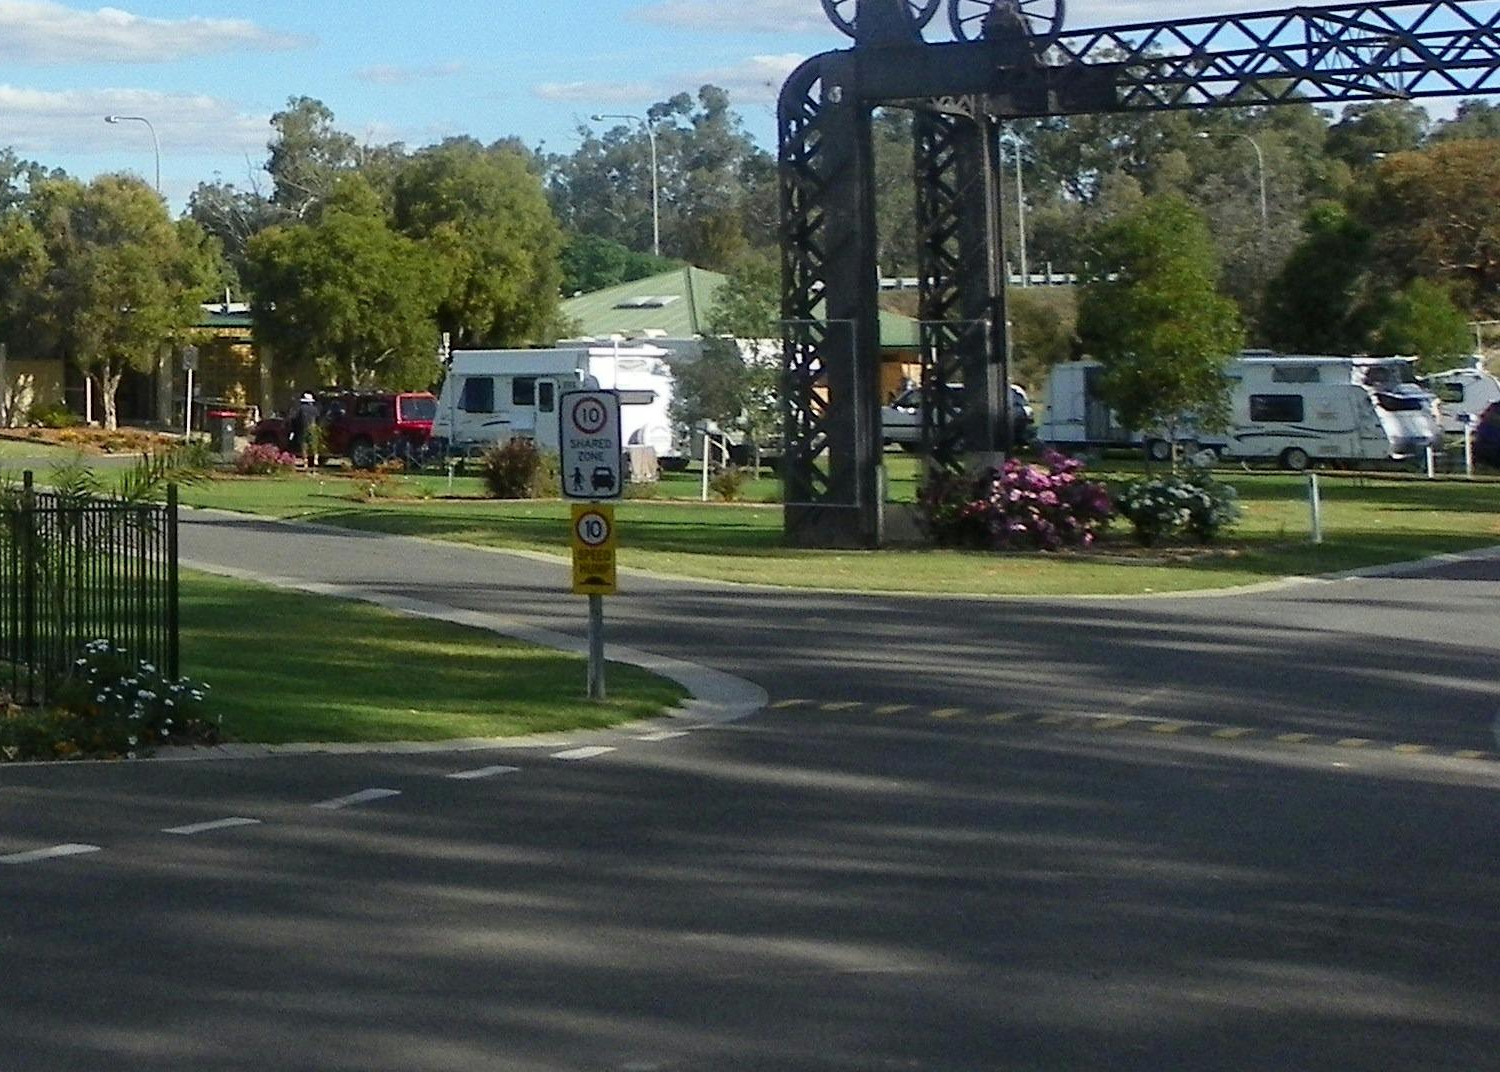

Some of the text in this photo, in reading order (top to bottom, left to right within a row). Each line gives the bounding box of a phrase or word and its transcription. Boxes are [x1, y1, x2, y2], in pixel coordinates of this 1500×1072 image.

[582, 408, 599, 423] 10
[570, 439, 613, 450] SHARED
[579, 451, 605, 462] ZONE
[585, 520, 602, 538] 10
[578, 549, 611, 561] SPEED
